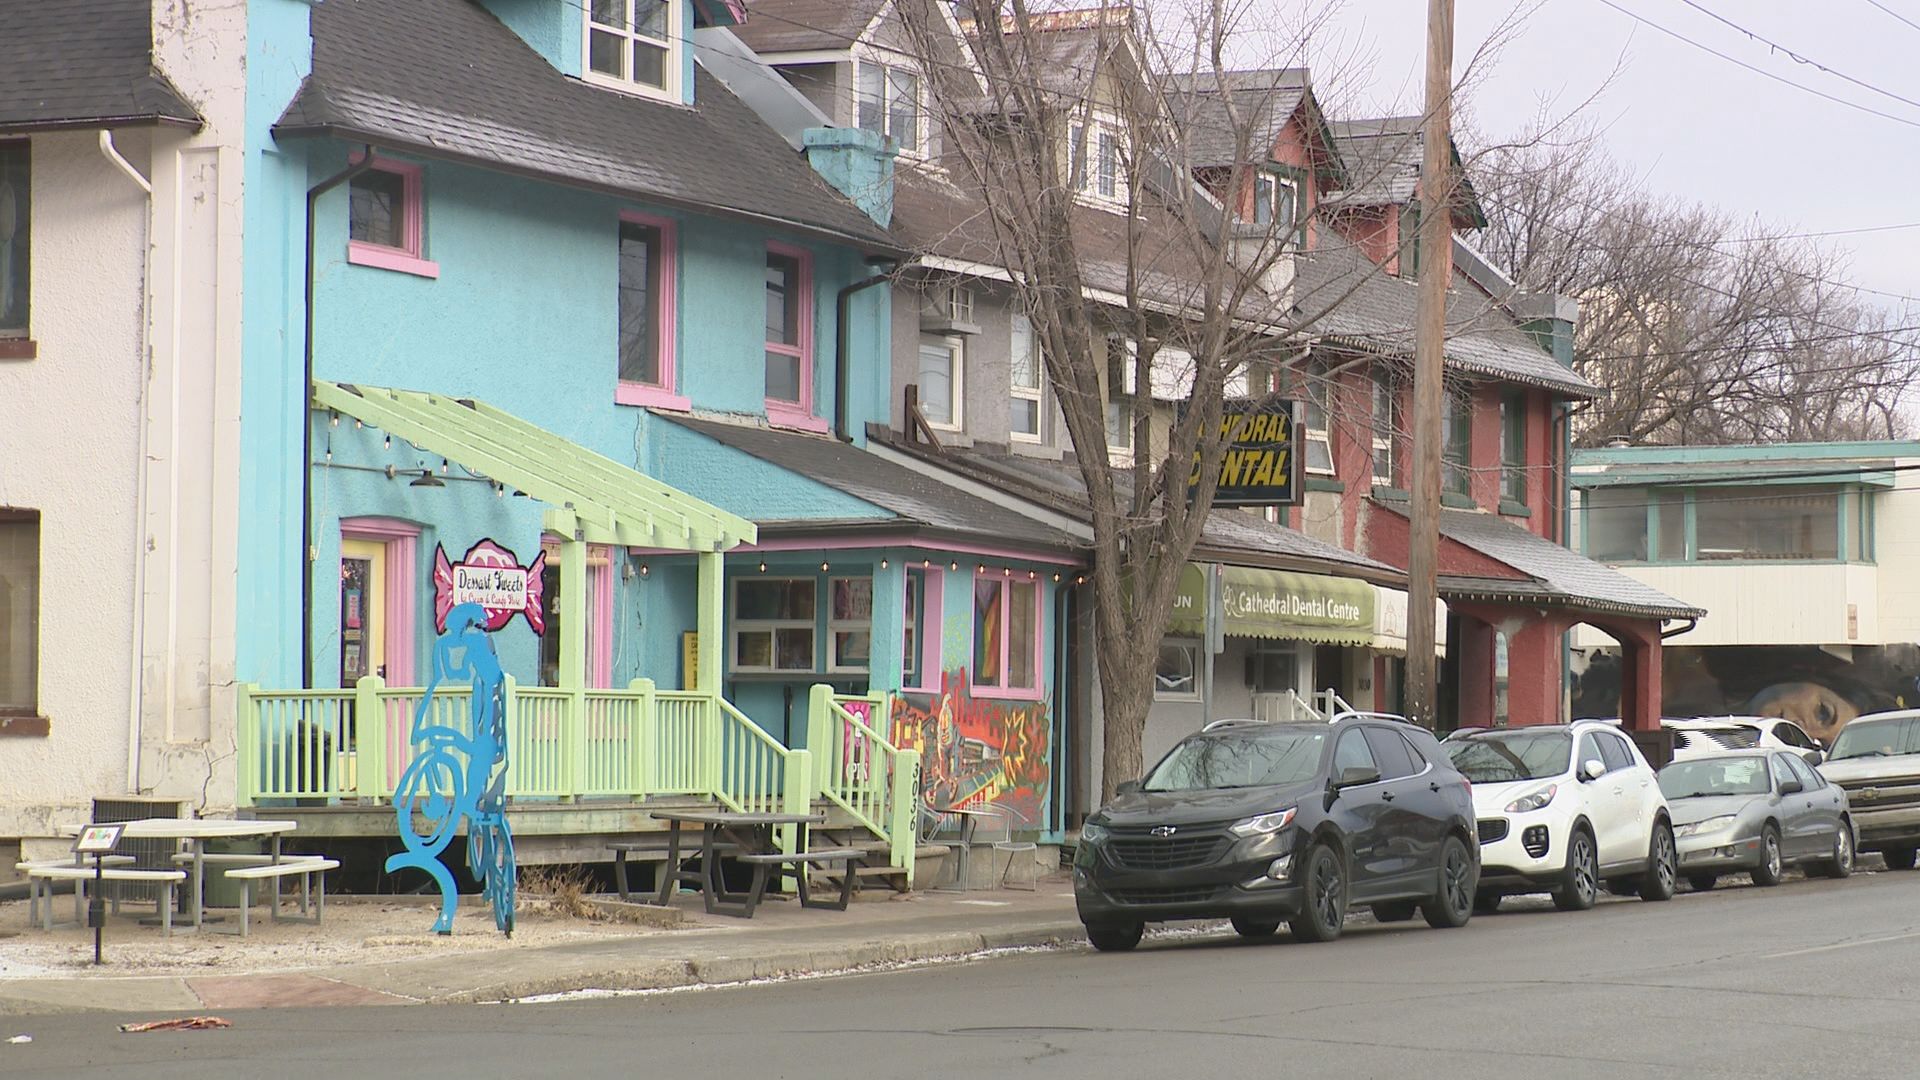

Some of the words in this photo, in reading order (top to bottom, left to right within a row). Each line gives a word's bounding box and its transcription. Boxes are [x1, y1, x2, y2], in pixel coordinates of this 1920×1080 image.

[1187, 450, 1288, 486] DNTAL
[494, 570, 523, 592] Sweets
[1239, 591, 1290, 615] Cathedral
[1292, 595, 1325, 618] Dental
[1327, 598, 1360, 621] Centre
[909, 762, 919, 831] 3036
